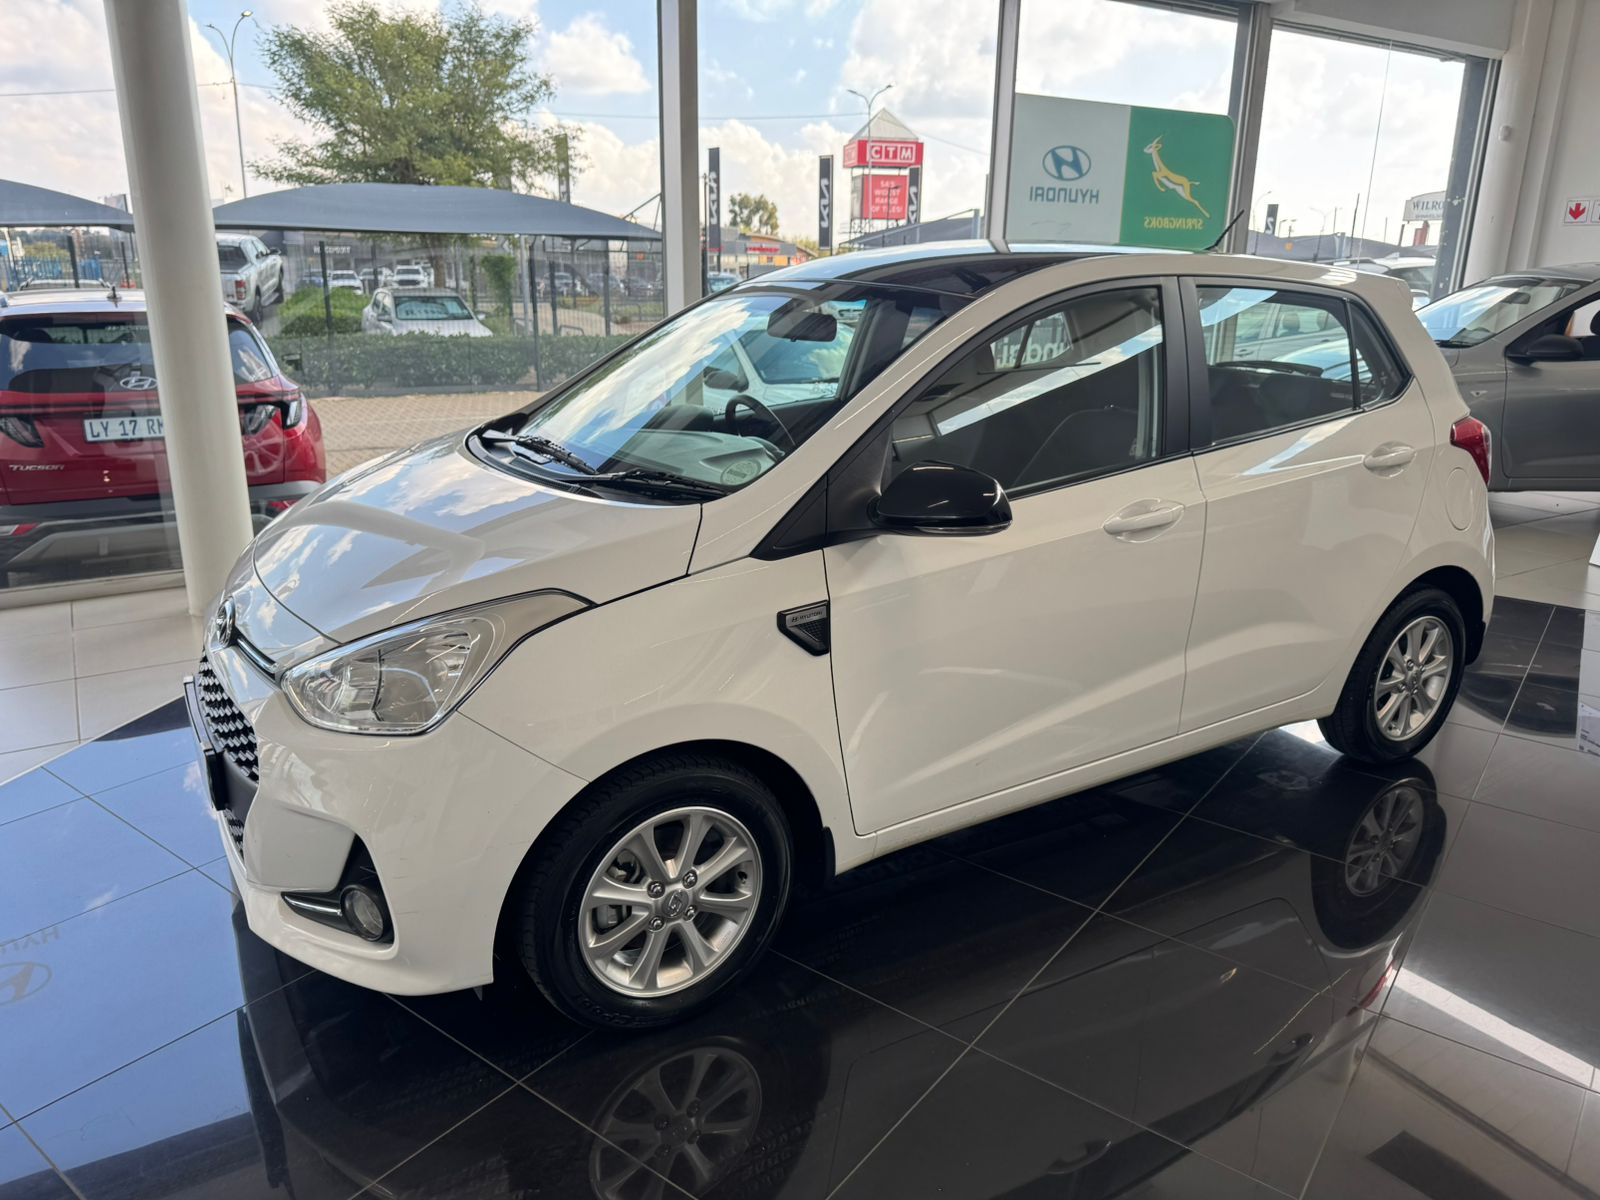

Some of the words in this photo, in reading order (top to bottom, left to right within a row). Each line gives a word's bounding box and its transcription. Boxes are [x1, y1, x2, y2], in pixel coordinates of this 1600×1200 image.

[871, 146, 912, 160] CTM
[88, 421, 109, 438] LY
[118, 419, 138, 437] 17
[8, 464, 65, 472] TUCSON
